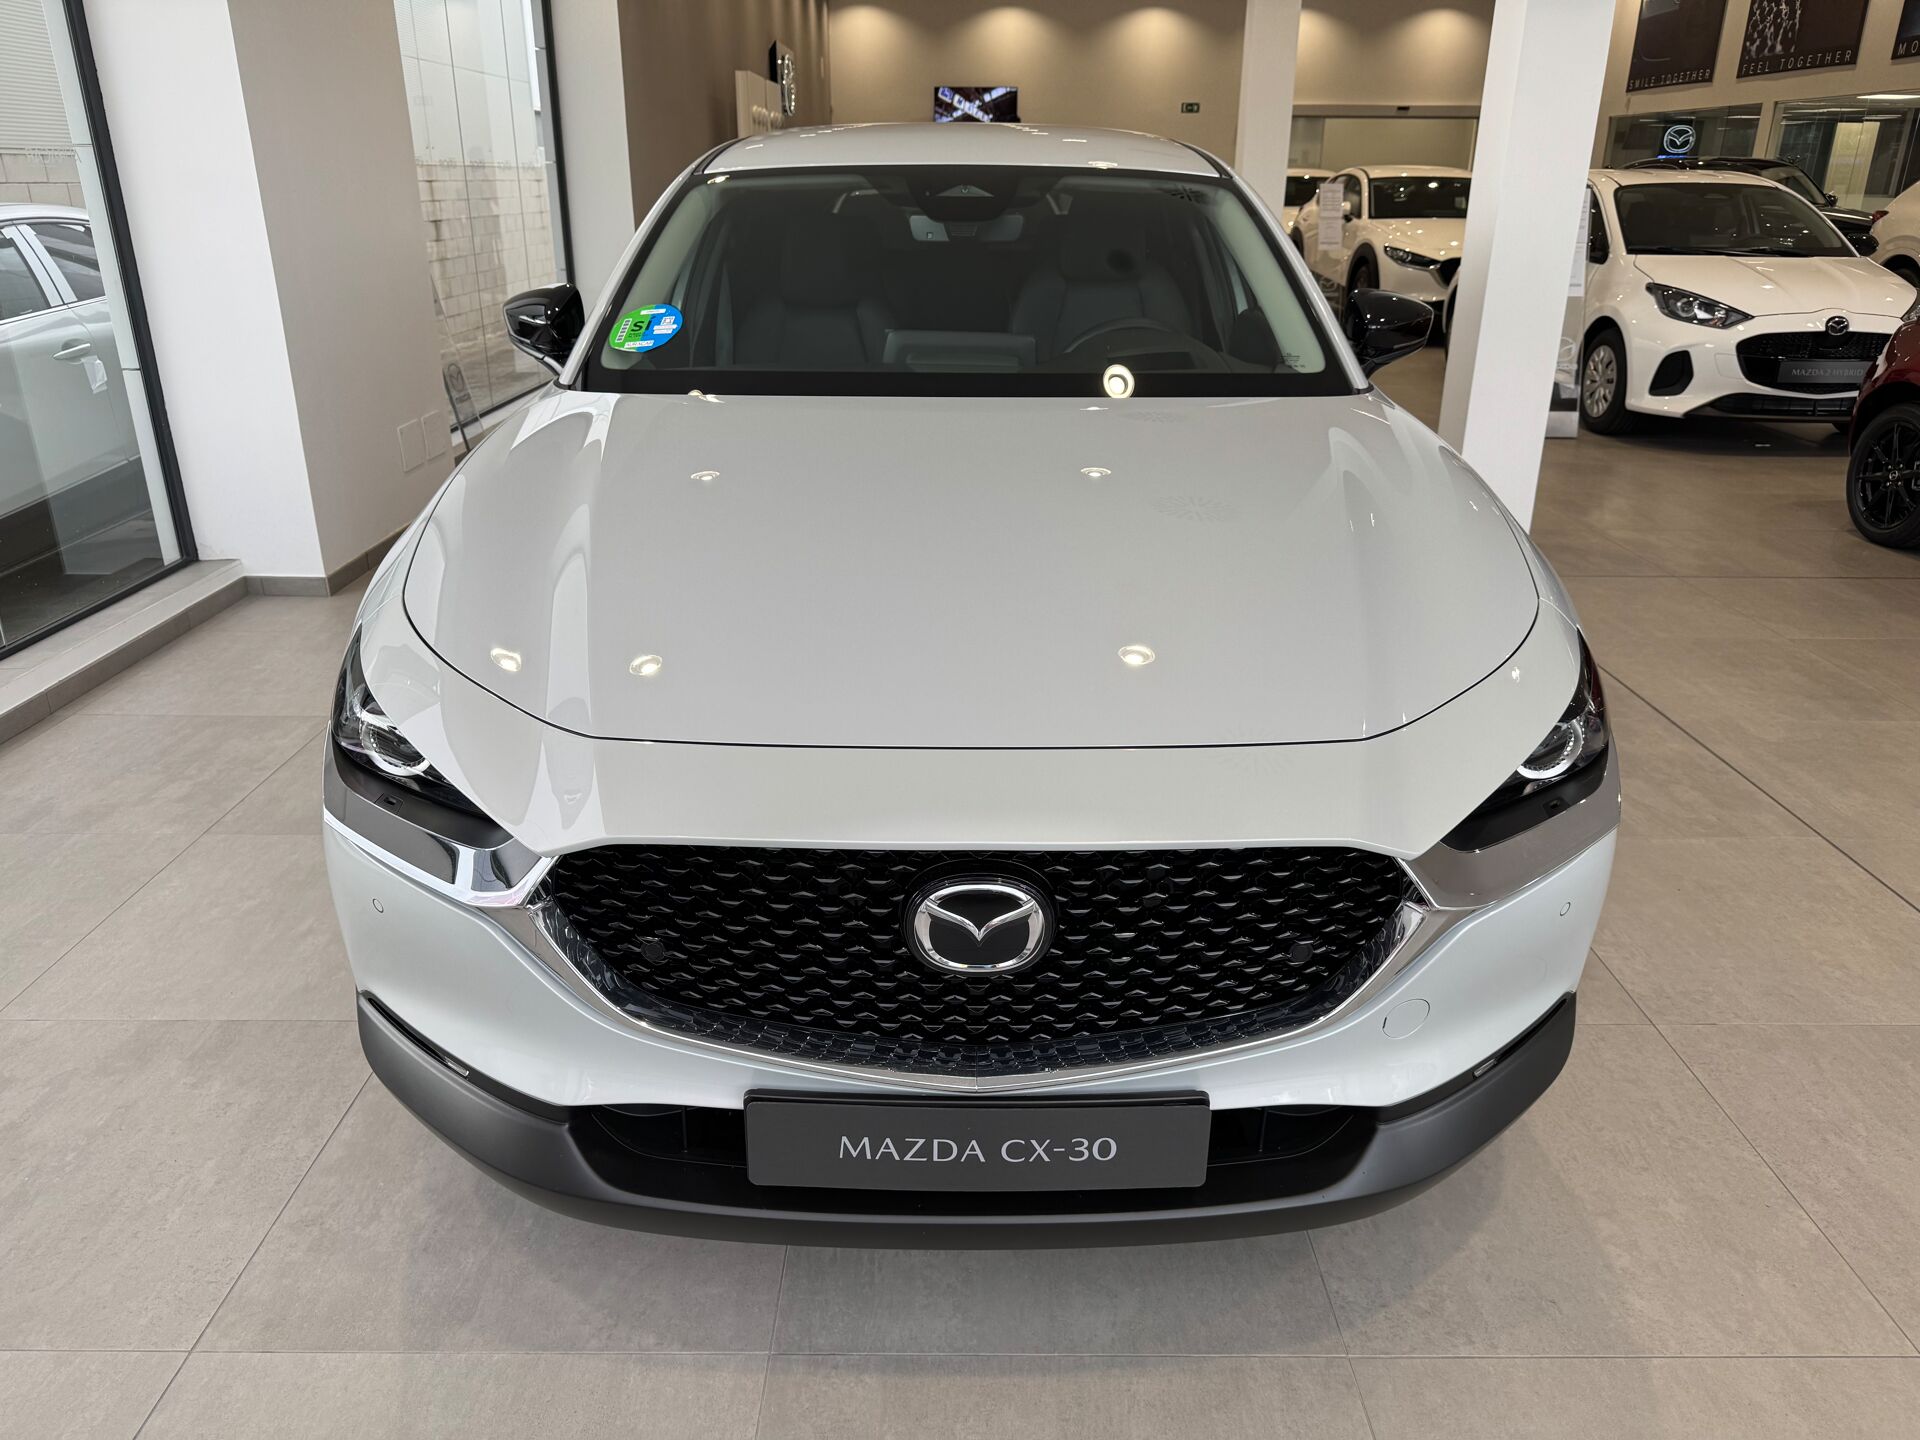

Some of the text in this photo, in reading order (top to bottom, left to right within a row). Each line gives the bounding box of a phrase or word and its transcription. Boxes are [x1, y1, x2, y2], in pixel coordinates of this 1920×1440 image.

[1742, 50, 1852, 75] FEEL TOGETHER
[1629, 69, 1711, 90] SMILE TOGETHER
[840, 1136, 1117, 1162] MAZDA CX-30
